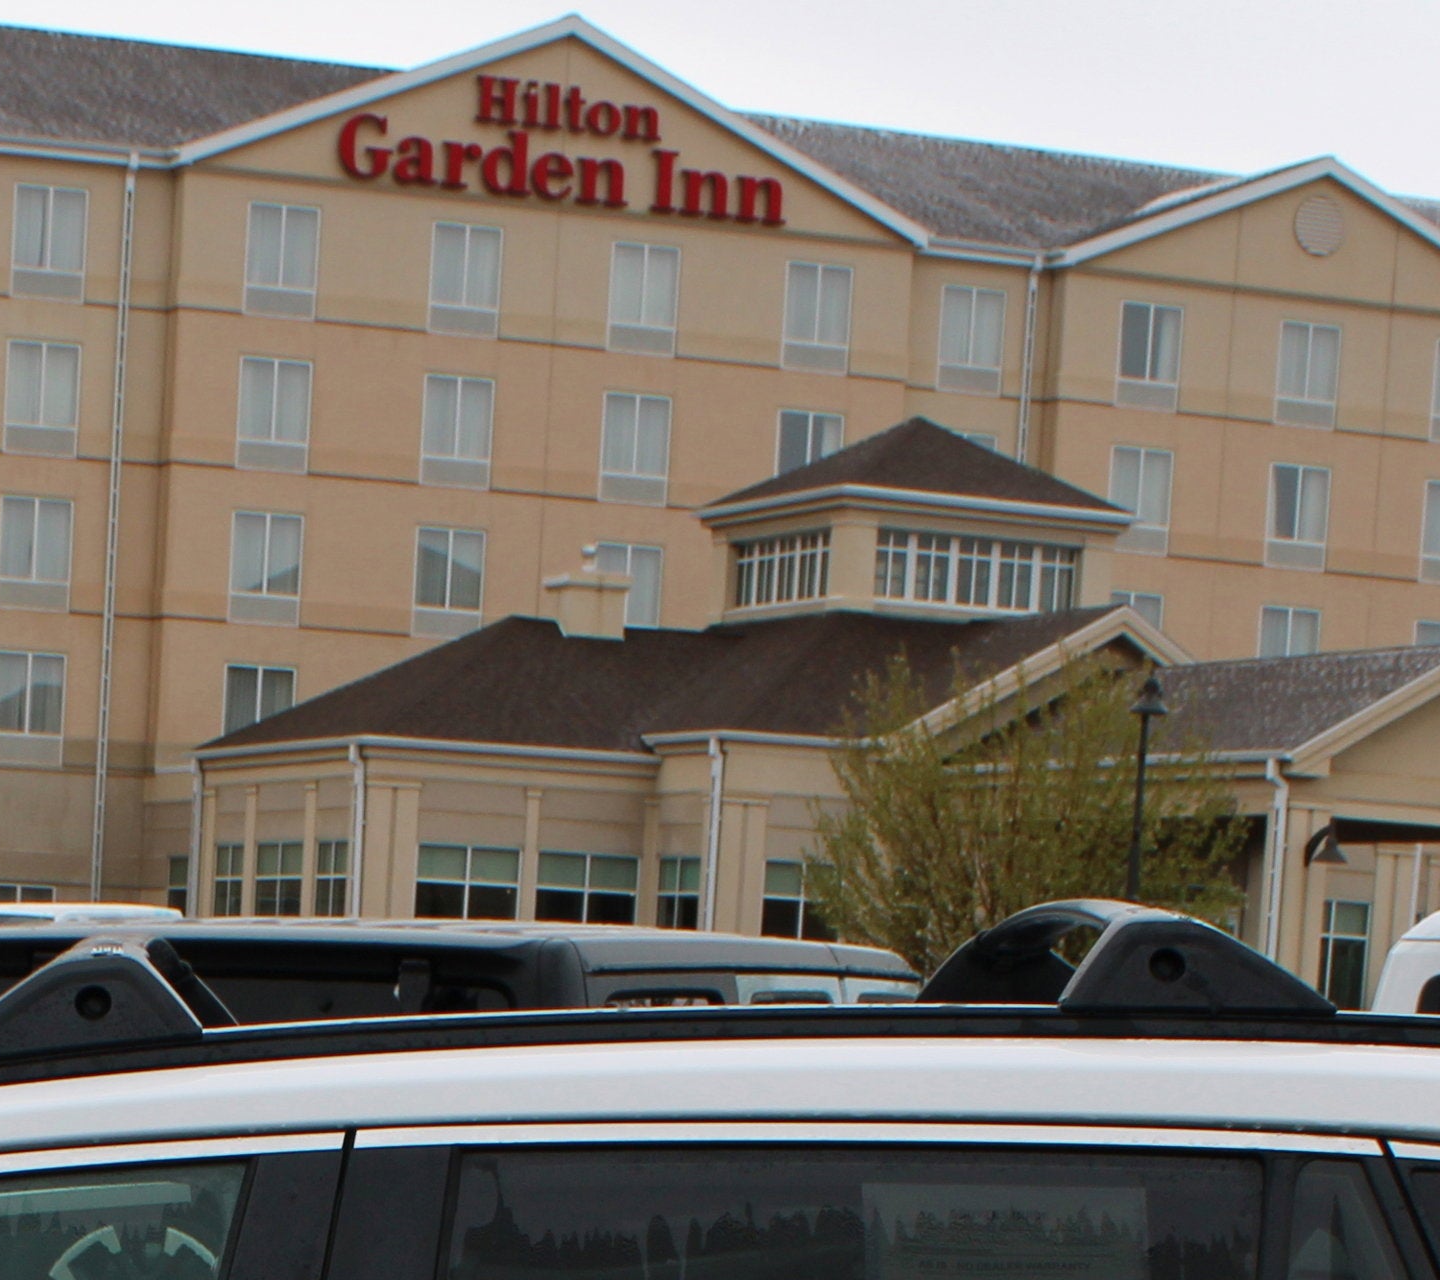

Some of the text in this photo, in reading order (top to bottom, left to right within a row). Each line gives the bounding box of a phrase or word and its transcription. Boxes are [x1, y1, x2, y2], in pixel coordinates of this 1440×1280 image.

[476, 74, 661, 143] Hilton
[338, 113, 786, 225] Garden Inn
